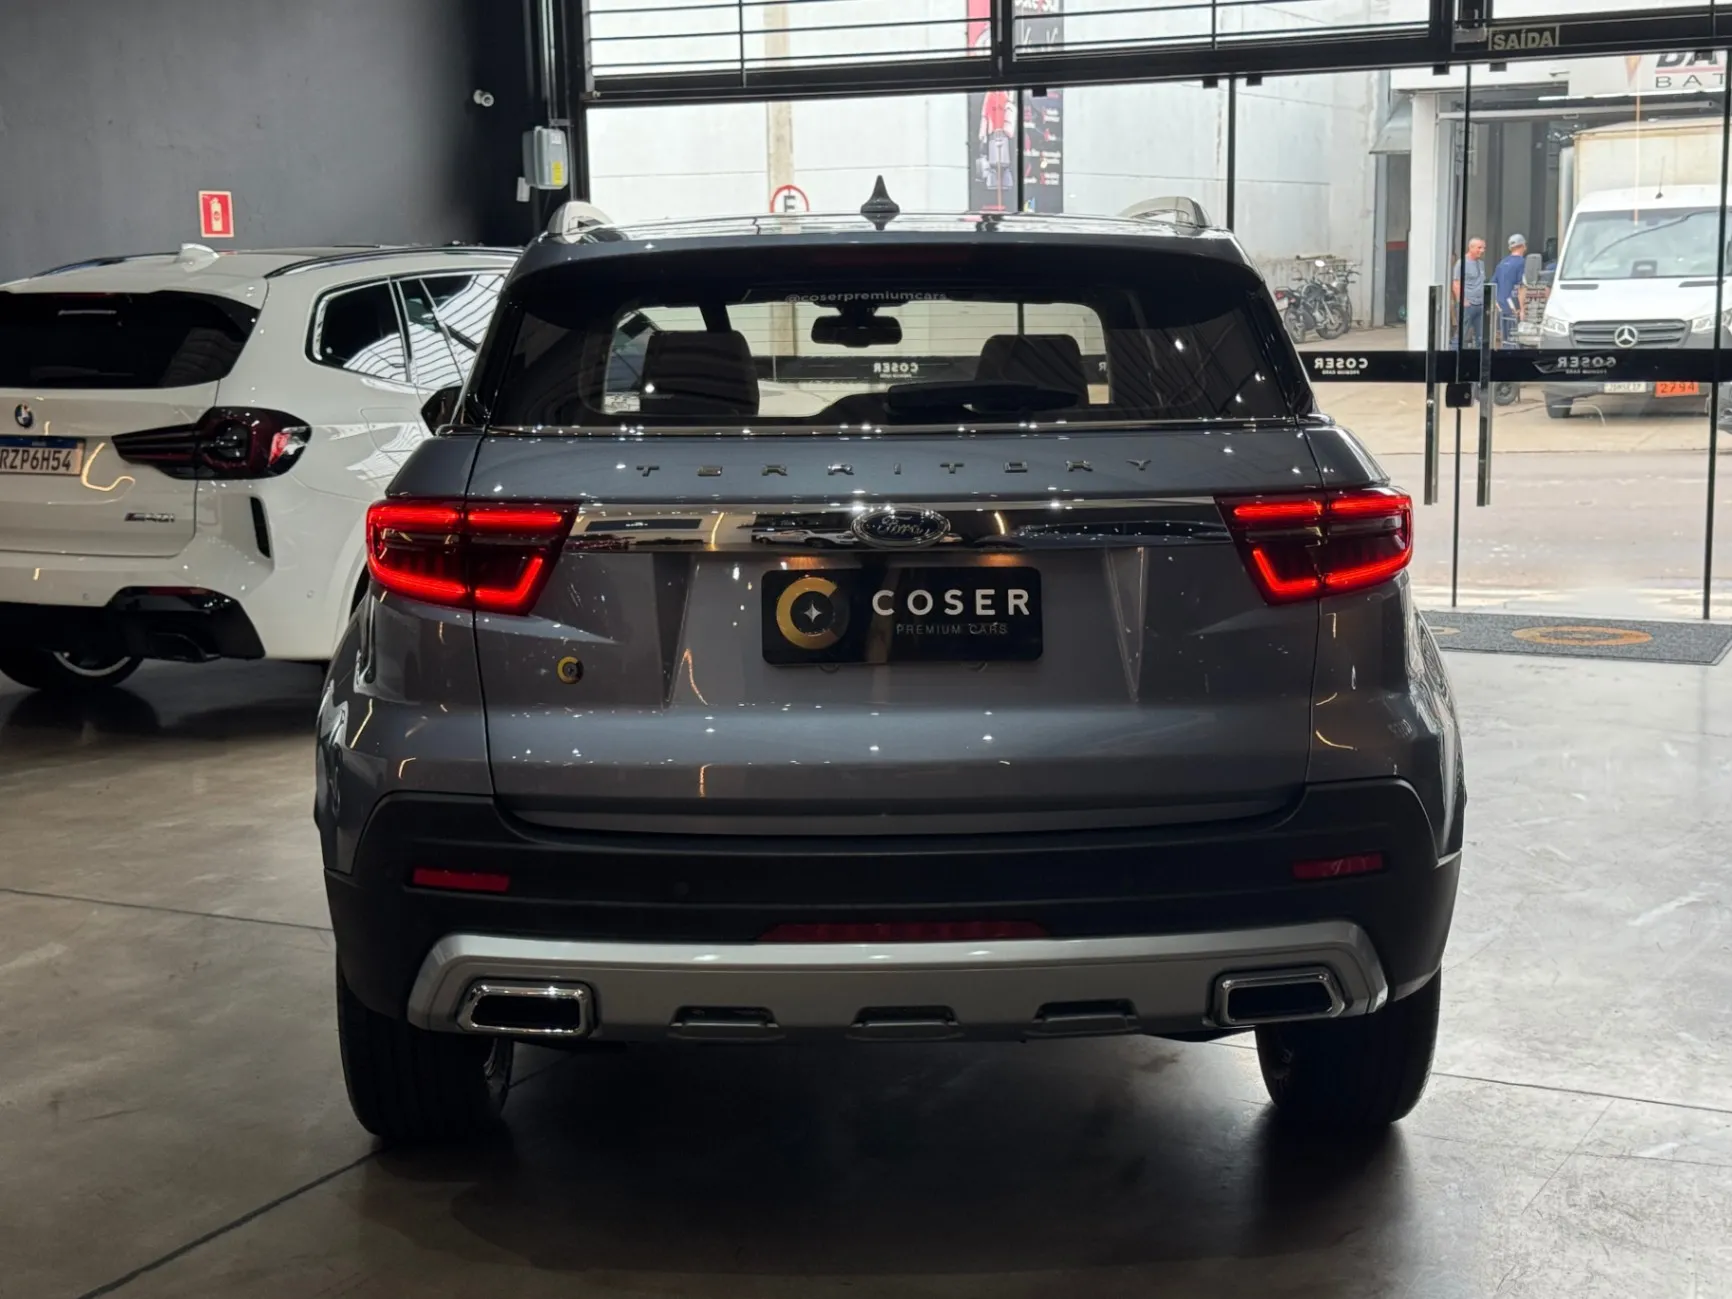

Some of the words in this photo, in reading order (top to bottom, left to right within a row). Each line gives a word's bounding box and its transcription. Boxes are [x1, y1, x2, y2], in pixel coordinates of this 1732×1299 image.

[1493, 29, 1553, 49] SAÍDA
[785, 291, 947, 303] @coserpremiumcars
[0, 449, 71, 471] RZP6H54
[636, 458, 1152, 477] TERRITORY
[872, 589, 1030, 616] COSER
[896, 624, 961, 635] PREMIUM
[969, 623, 1009, 635] CARS
